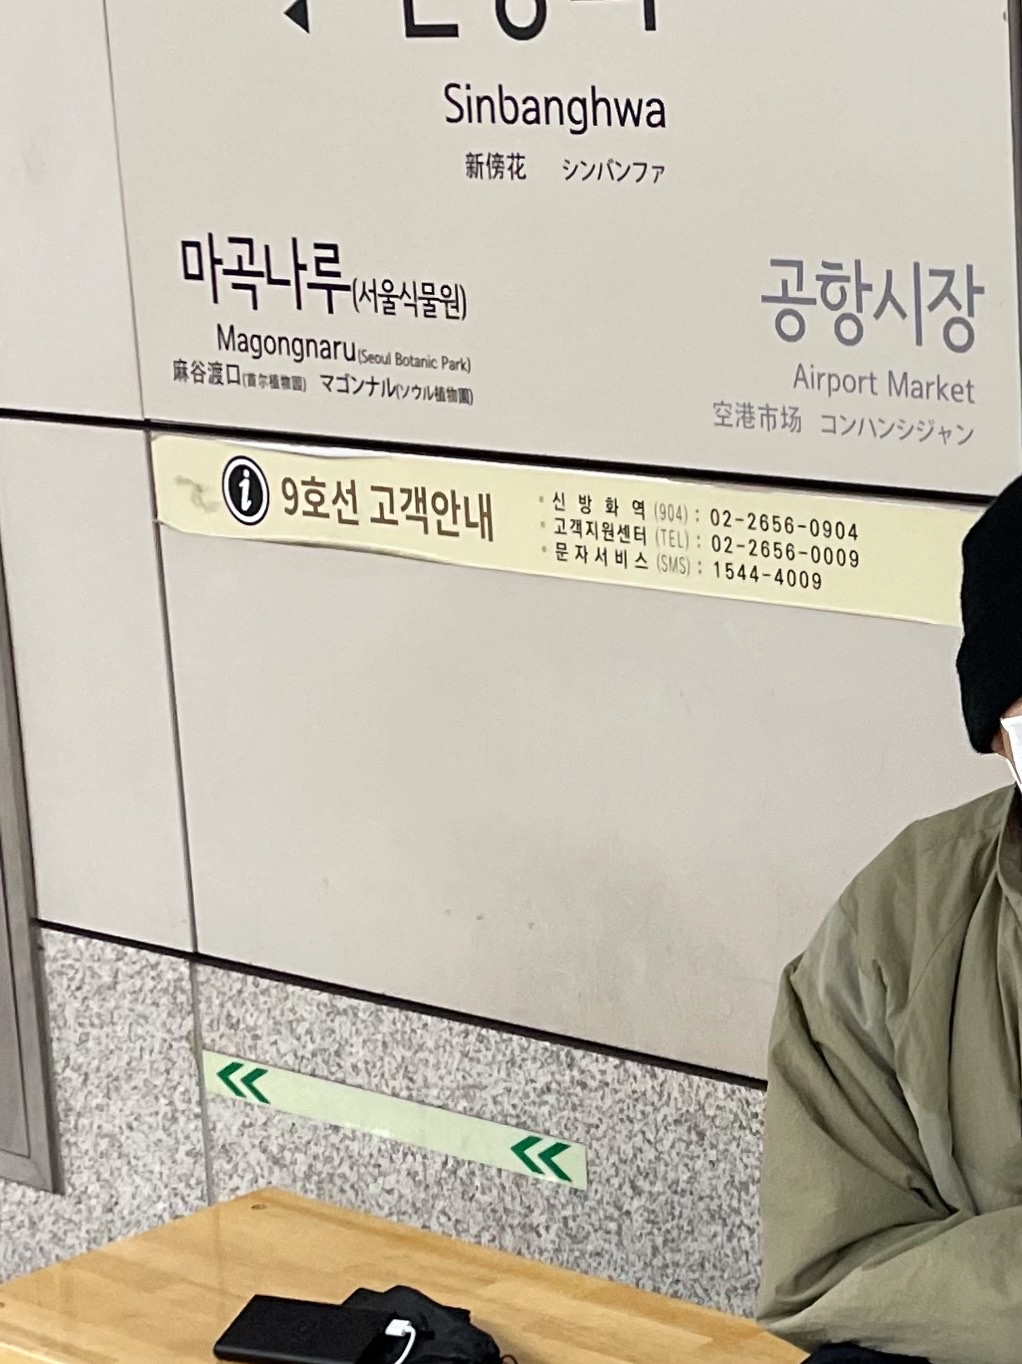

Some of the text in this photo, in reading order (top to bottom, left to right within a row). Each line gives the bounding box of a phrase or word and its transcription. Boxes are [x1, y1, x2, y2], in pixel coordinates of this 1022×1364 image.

[444, 82, 667, 136] Sinbanghwa
[465, 151, 527, 181] 新傍花
[562, 157, 666, 184] シンバンファ
[760, 258, 986, 354] 공항시장
[394, 351, 439, 370] Botanic
[440, 354, 472, 374] Park)
[792, 362, 976, 405] Airport Market
[712, 399, 802, 434] 空港市场
[280, 474, 494, 543] 9호선 고객안내
[653, 501, 690, 524] (904)
[709, 507, 859, 542] 02-2656-0904
[553, 516, 648, 547] 고객지원센터
[654, 526, 690, 551] (TEL)
[711, 534, 860, 569] 02-2656-0009
[656, 552, 692, 578] (SMS)
[713, 560, 823, 591] 1544-4009
